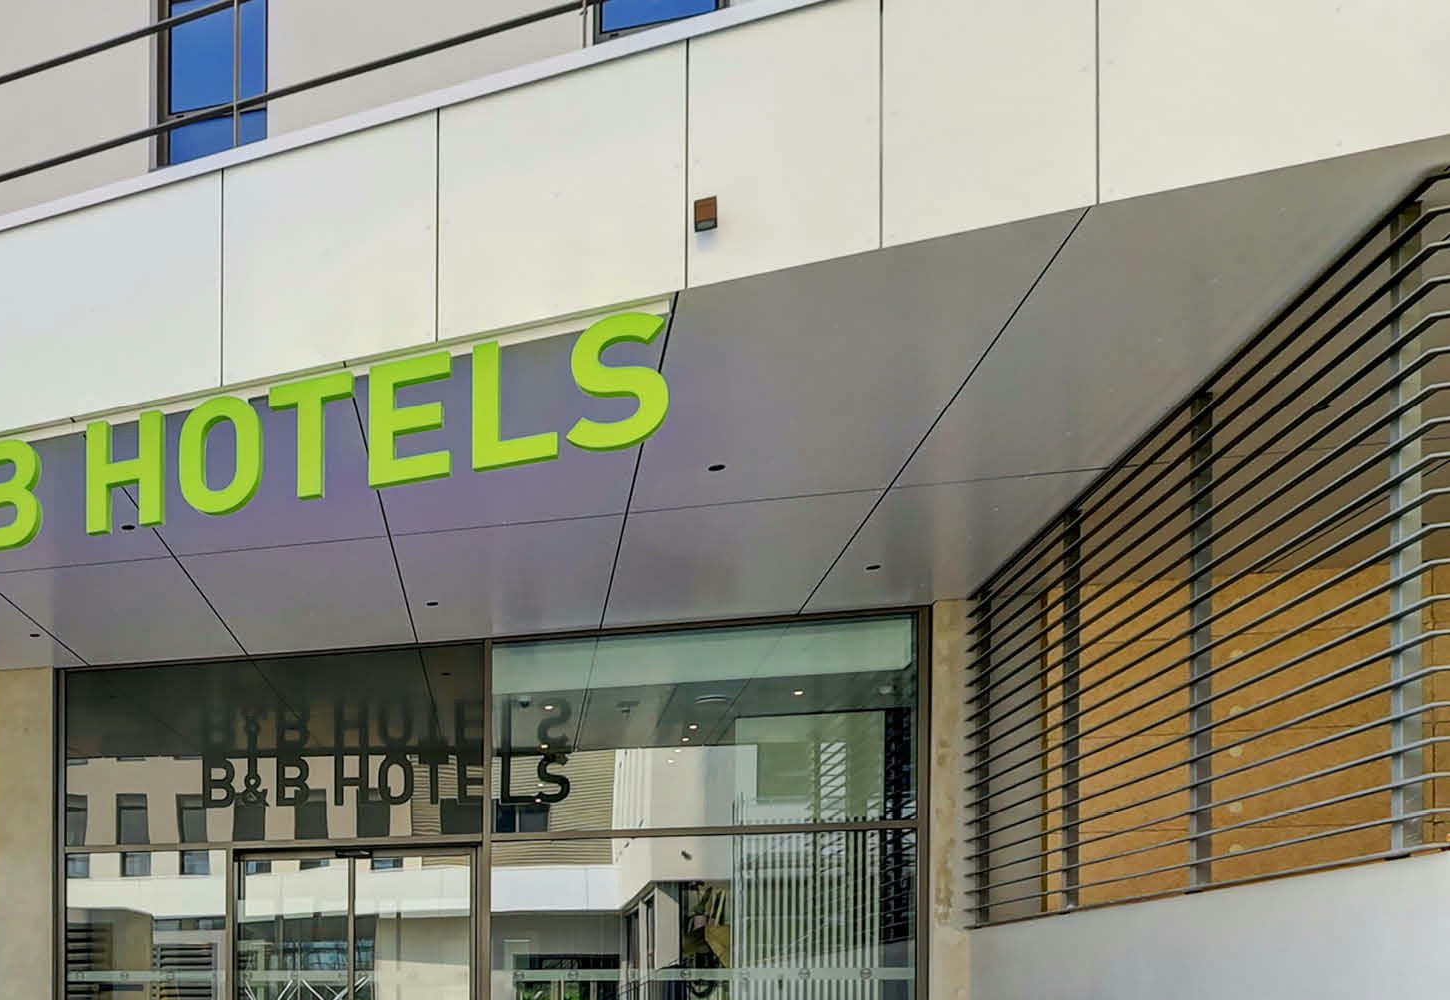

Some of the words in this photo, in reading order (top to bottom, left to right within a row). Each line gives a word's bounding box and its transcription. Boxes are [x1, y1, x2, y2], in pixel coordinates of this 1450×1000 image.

[85, 311, 669, 536] HOTELS
[203, 757, 310, 808] B&B
[334, 753, 571, 806] HOTELS
